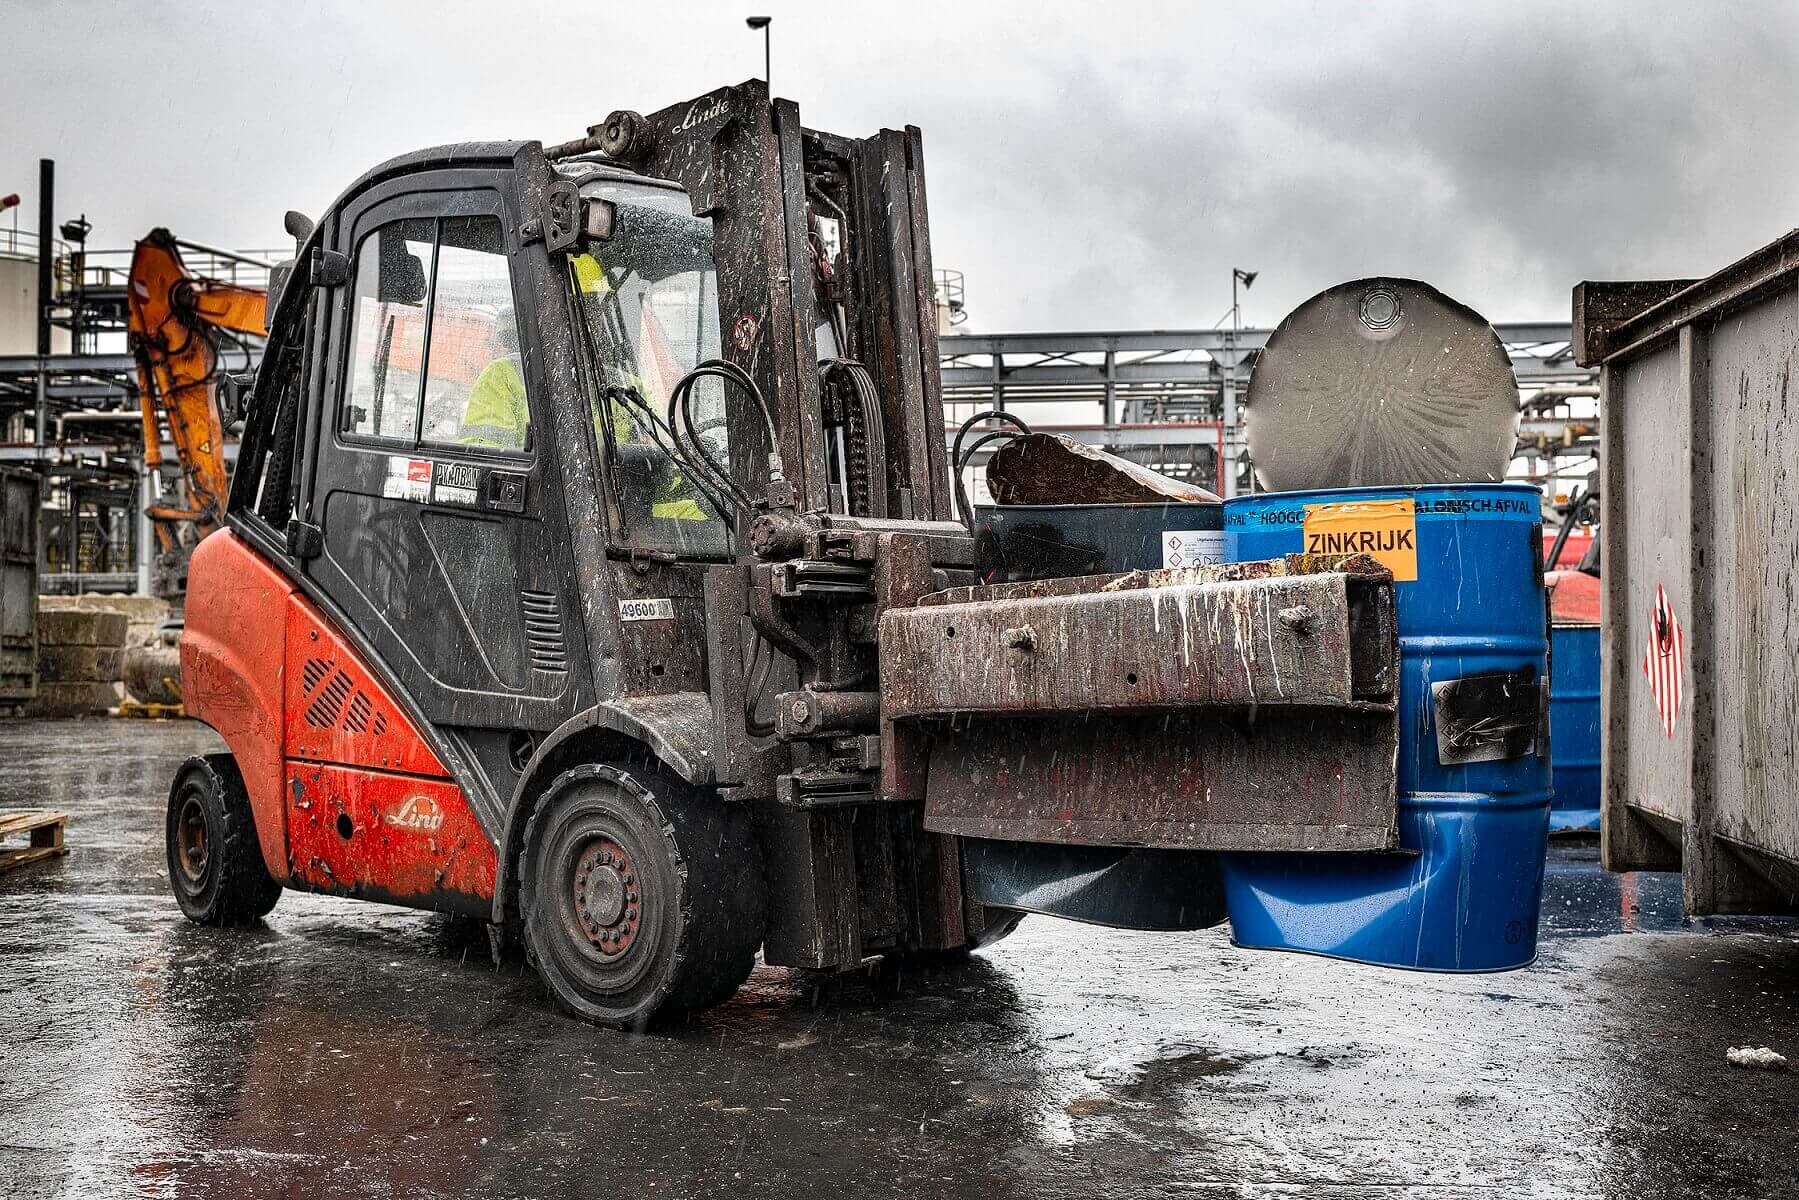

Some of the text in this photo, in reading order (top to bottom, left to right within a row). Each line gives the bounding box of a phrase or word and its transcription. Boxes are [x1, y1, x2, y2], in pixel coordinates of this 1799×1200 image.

[672, 96, 730, 135] Linde
[1494, 499, 1532, 514] AFVAL
[1308, 529, 1415, 555] ZINKRIJK
[621, 602, 656, 617] 49600
